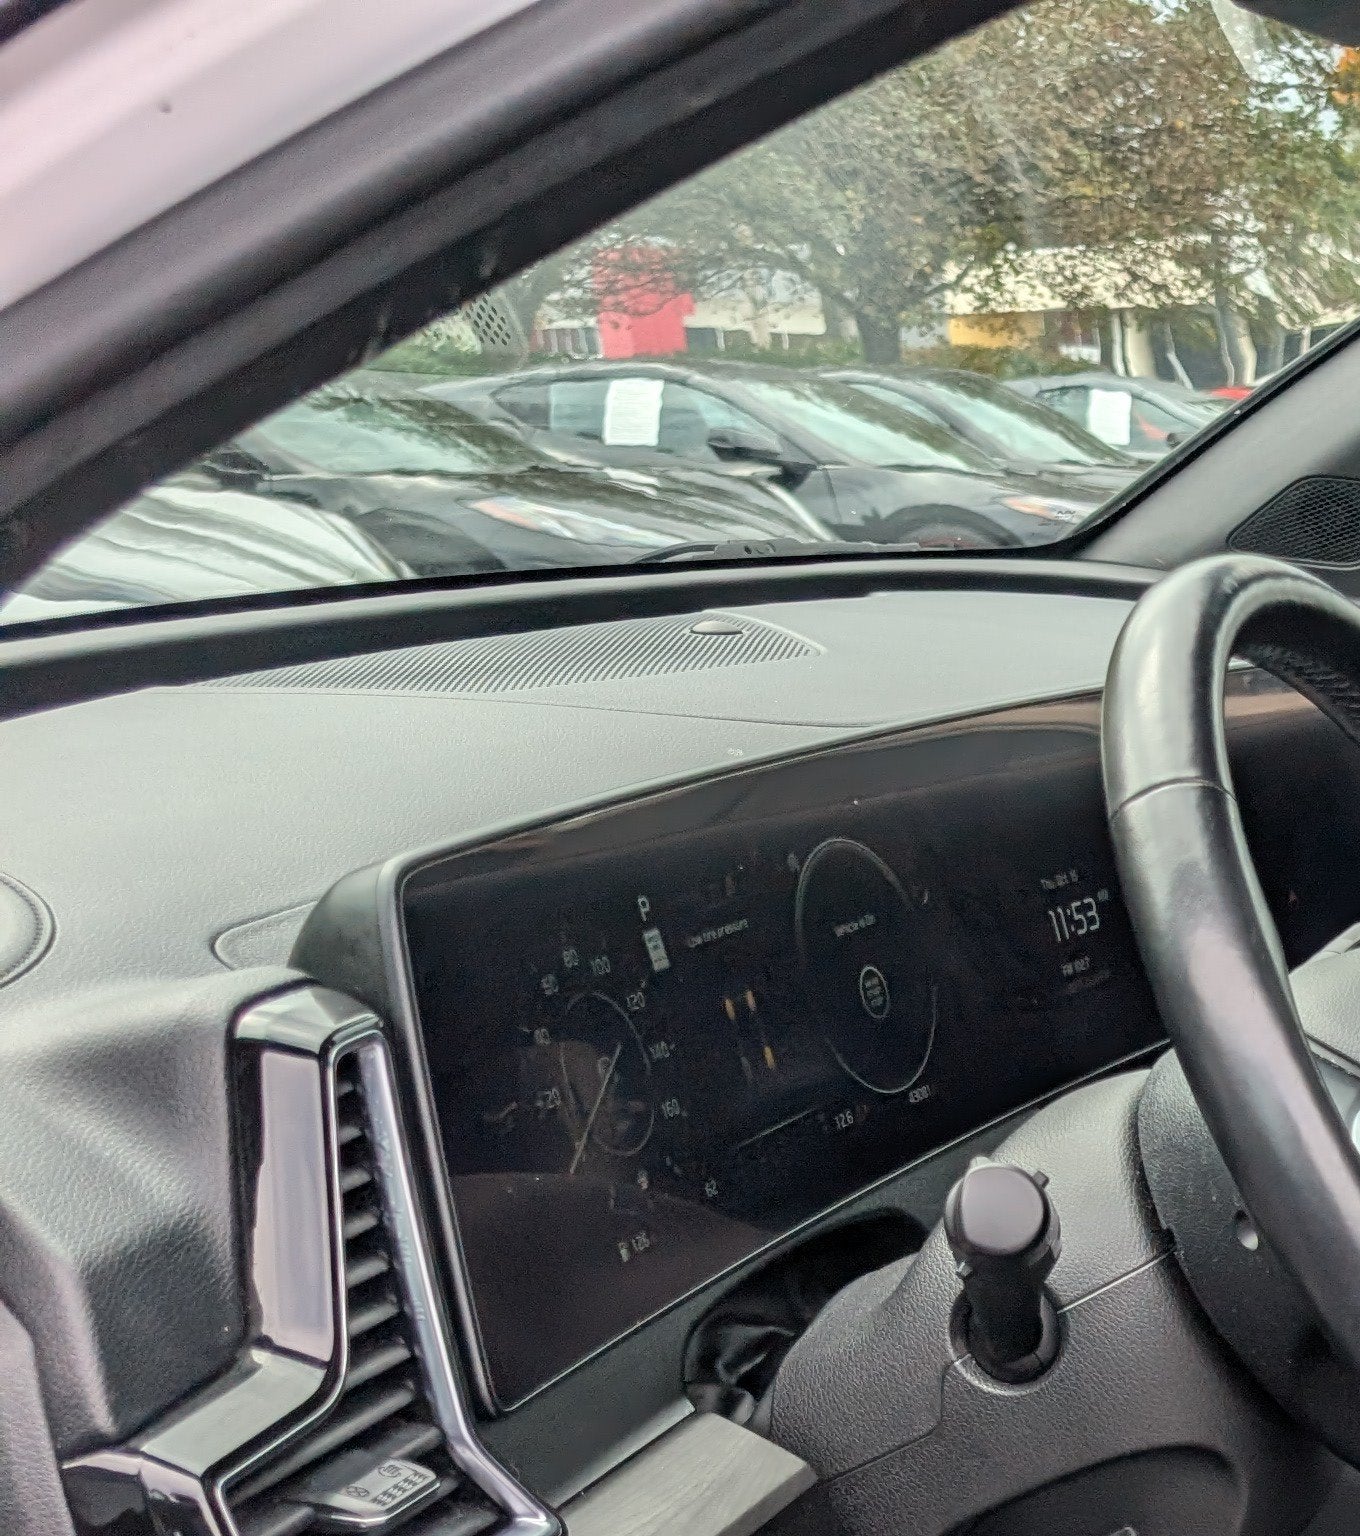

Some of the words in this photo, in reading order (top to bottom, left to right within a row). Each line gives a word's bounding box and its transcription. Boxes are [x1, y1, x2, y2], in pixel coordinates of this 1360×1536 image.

[637, 894, 650, 922] P
[1048, 896, 1101, 943] 11:53
[591, 956, 611, 975] 100
[626, 991, 646, 1012] 120
